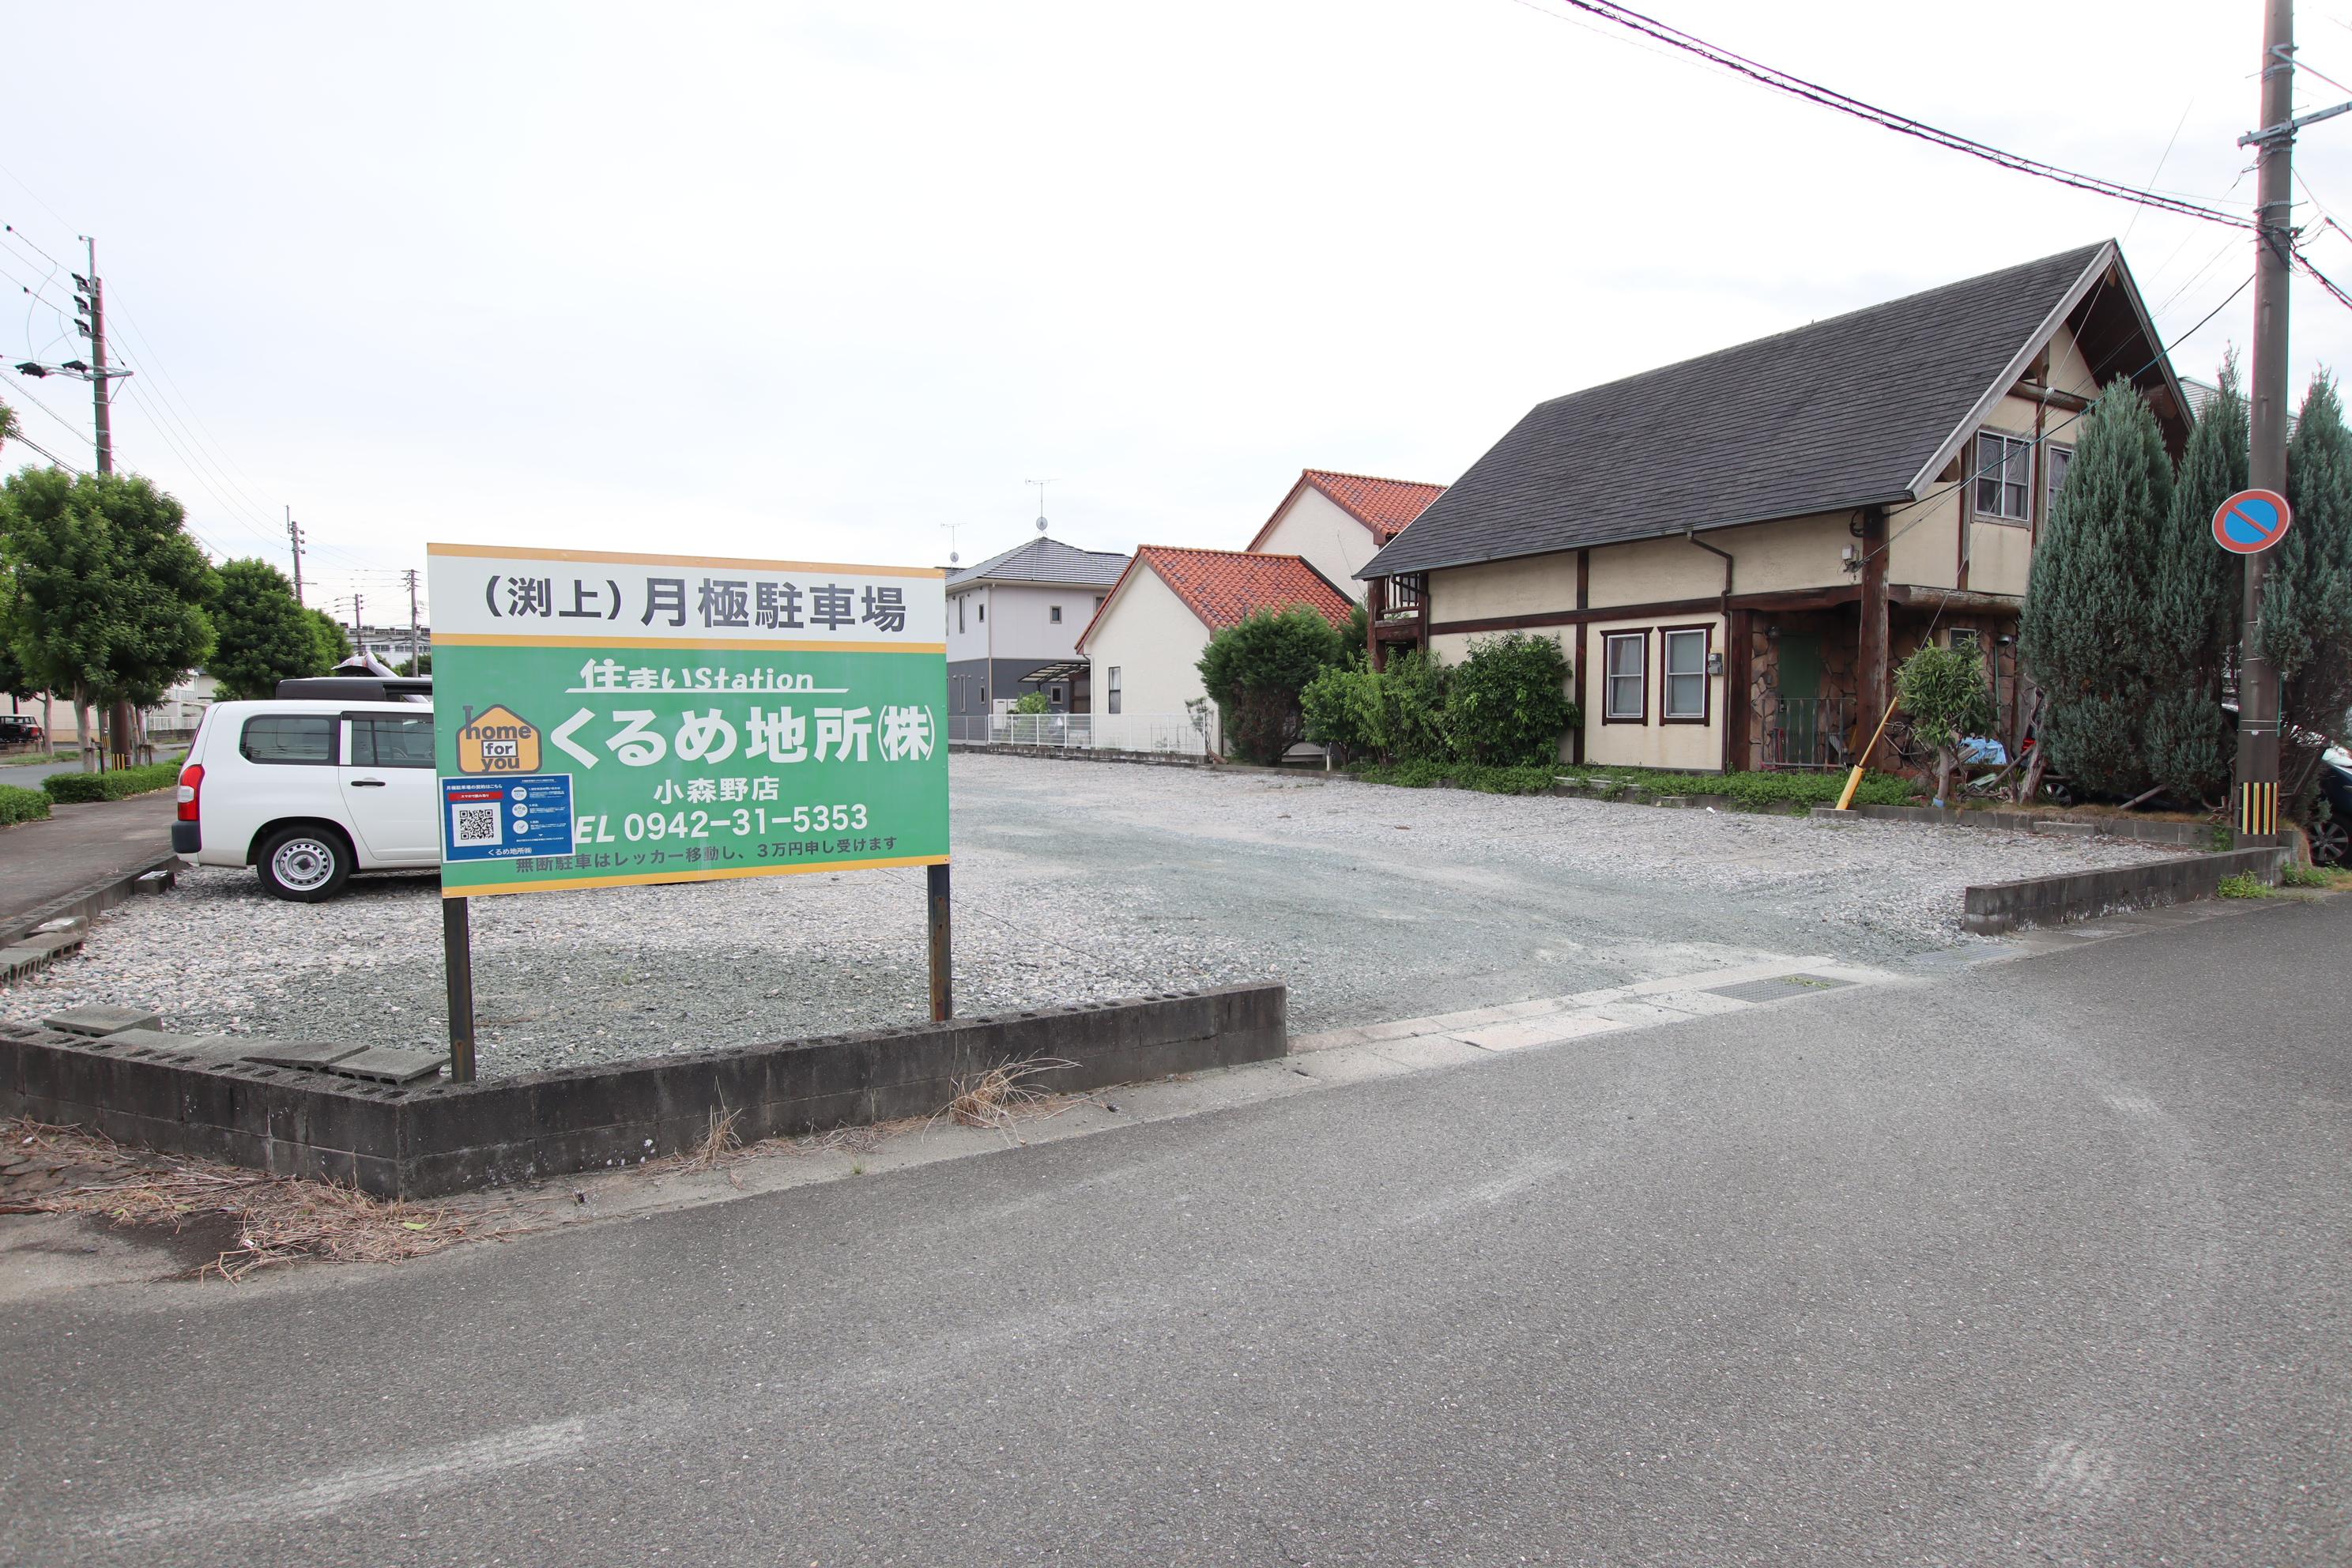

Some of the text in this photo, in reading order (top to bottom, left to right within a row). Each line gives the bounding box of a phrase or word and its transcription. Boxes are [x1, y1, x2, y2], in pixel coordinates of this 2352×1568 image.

[462, 706, 532, 740] home
[550, 705, 935, 770] くるめ地所(株)
[481, 757, 520, 773] you
[485, 743, 514, 756] for
[653, 776, 779, 805] 小森野店
[575, 804, 868, 844] EL 0942-31-5353
